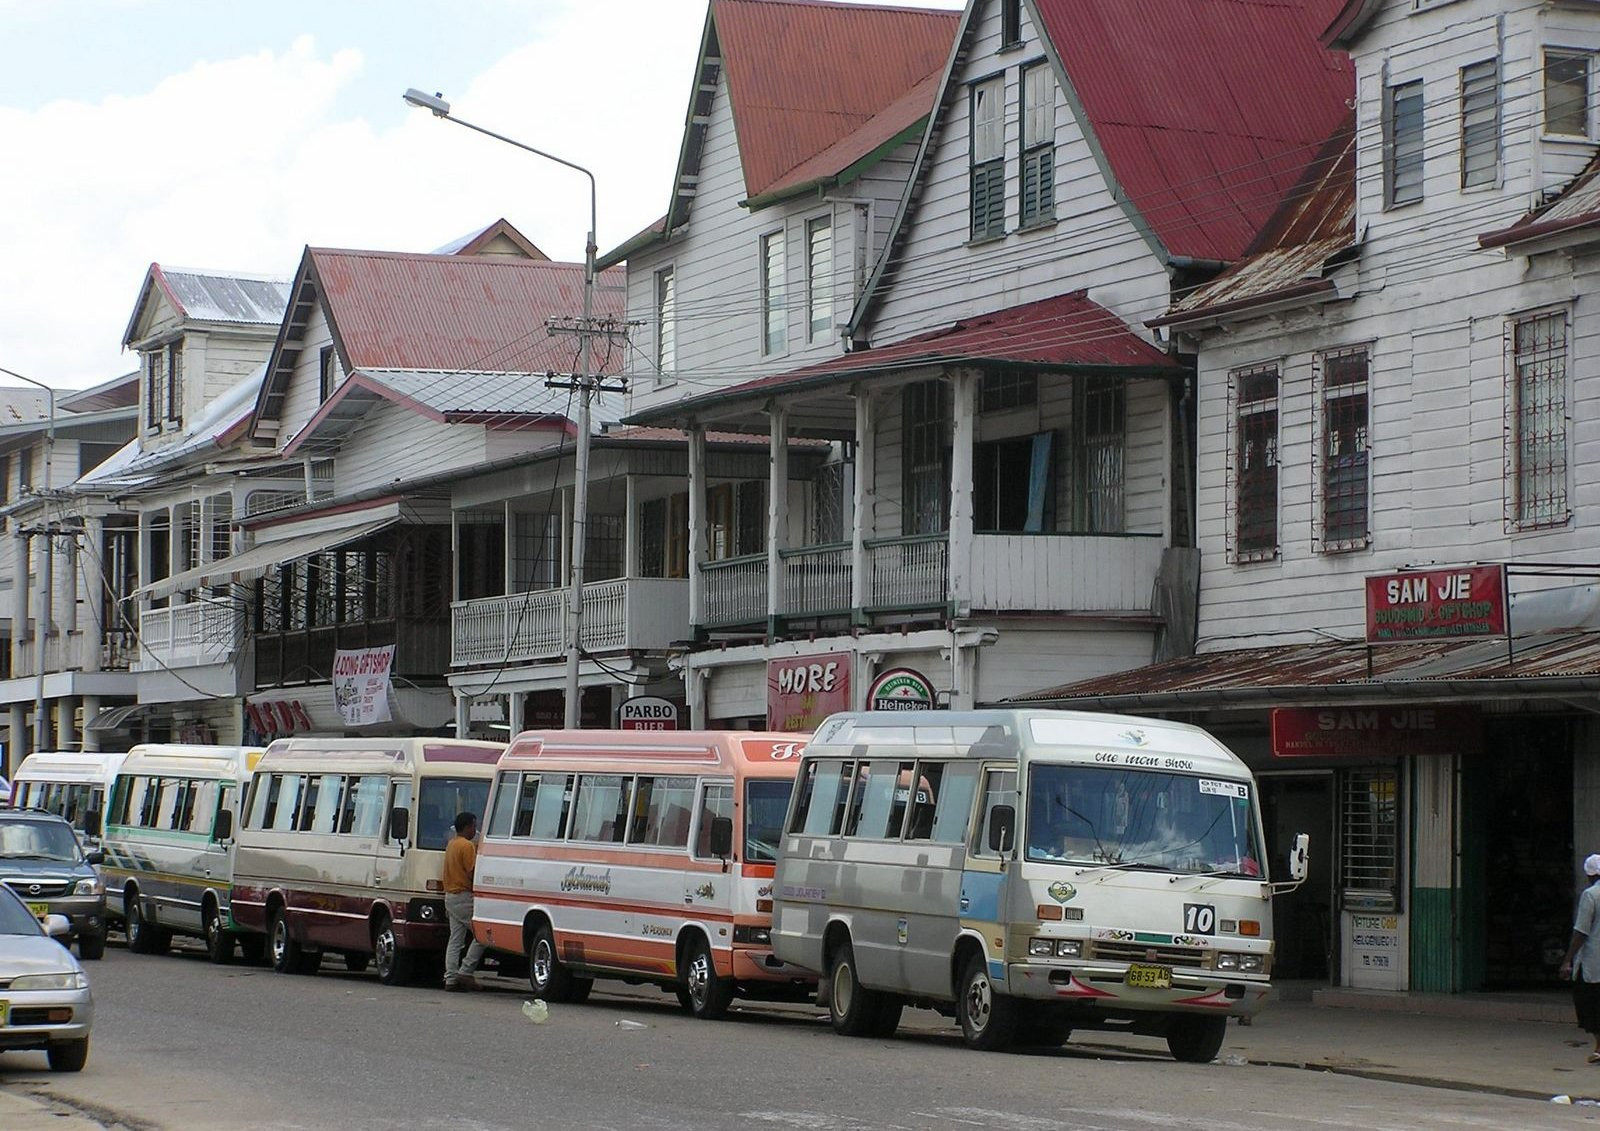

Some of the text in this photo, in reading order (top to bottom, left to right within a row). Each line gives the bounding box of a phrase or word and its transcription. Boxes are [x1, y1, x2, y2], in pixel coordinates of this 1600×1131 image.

[1387, 574, 1471, 604] SAM JIE
[778, 662, 838, 695] MORE
[625, 705, 672, 718] PARBO
[878, 699, 929, 711] Heineken
[635, 721, 665, 731] BIER
[1318, 709, 1436, 730] SAM JIE
[1237, 786, 1246, 797] B
[1186, 906, 1213, 932] 10
